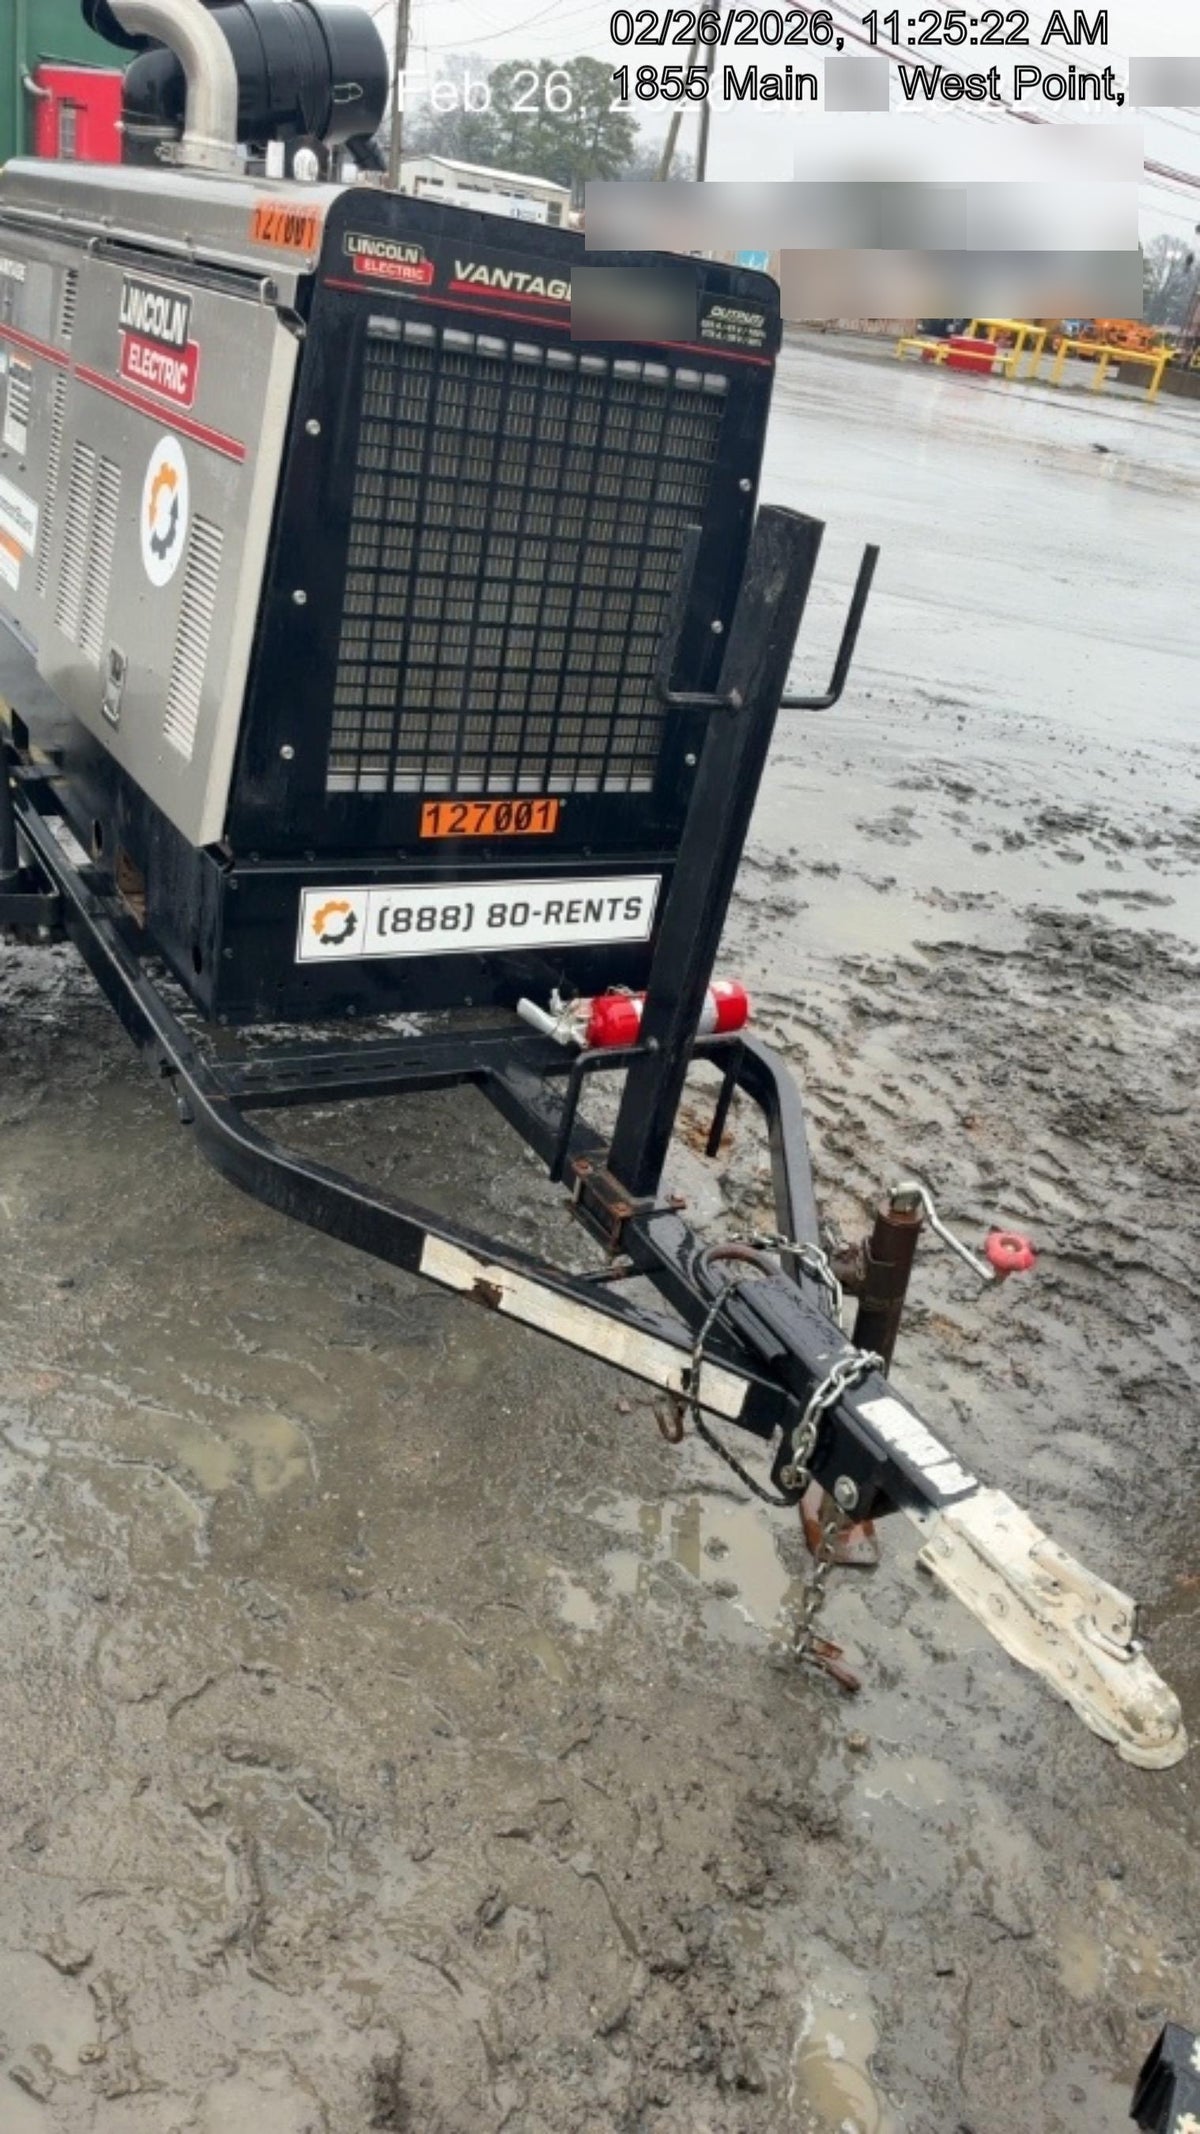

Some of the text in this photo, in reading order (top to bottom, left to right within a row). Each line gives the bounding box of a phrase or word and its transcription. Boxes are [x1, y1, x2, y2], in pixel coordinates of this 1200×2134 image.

[348, 236, 419, 264] LINCOLN
[363, 260, 424, 281] ELECTRIC
[119, 283, 189, 346] LINCOLN
[127, 343, 189, 395] ELECTRIC
[425, 803, 553, 834] 127001
[376, 896, 643, 936] (888) 80-RENTS
